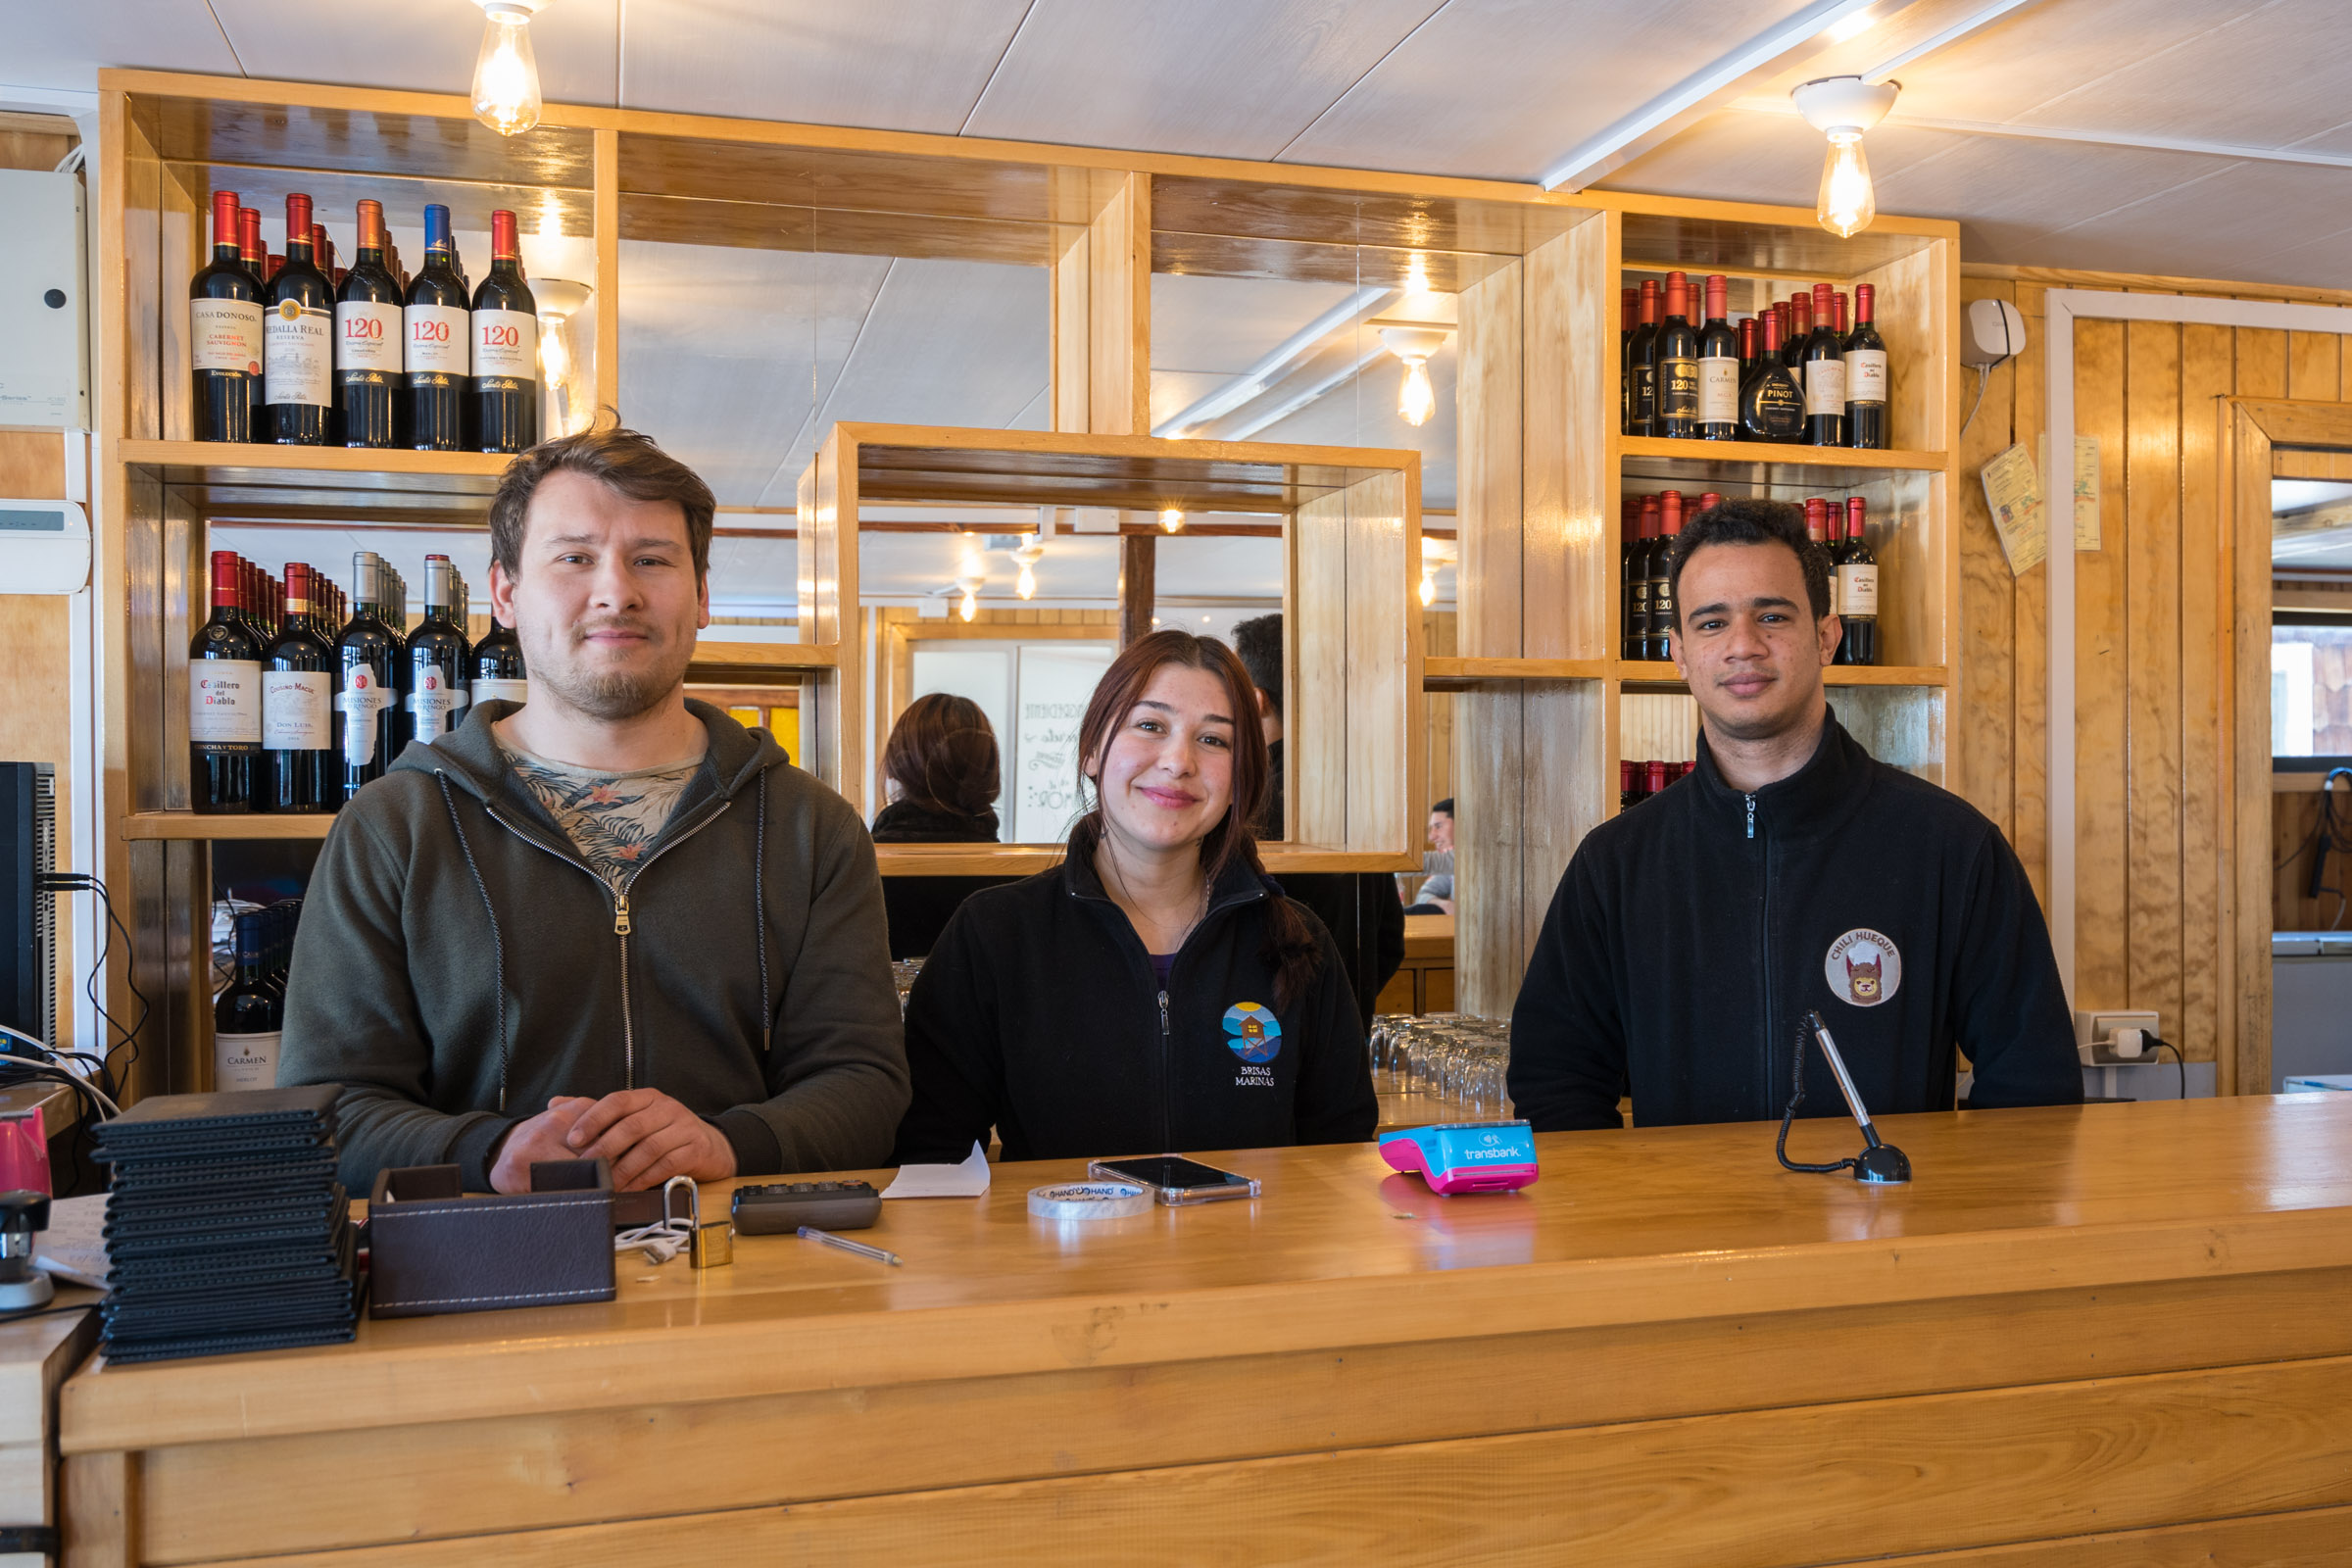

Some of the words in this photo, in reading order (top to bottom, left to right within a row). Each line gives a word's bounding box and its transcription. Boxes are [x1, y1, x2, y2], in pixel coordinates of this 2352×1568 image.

[216, 311, 255, 321] DONOSO
[300, 324, 324, 336] REAL
[345, 318, 382, 339] 120
[413, 320, 450, 342] 120
[481, 325, 518, 347] 120
[1671, 379, 1689, 391] 120
[1642, 386, 1653, 397] 12
[1767, 389, 1793, 399] PINOT
[1654, 599, 1672, 610] 120
[205, 695, 236, 706] Diablo
[1831, 935, 1854, 960] CHILI
[1855, 931, 1896, 957] HUEQUE
[226, 1055, 268, 1065] CARMEN
[1240, 1066, 1271, 1076] BRISAS
[1235, 1076, 1275, 1087] MARINAS
[1090, 1187, 1114, 1196] HAND
